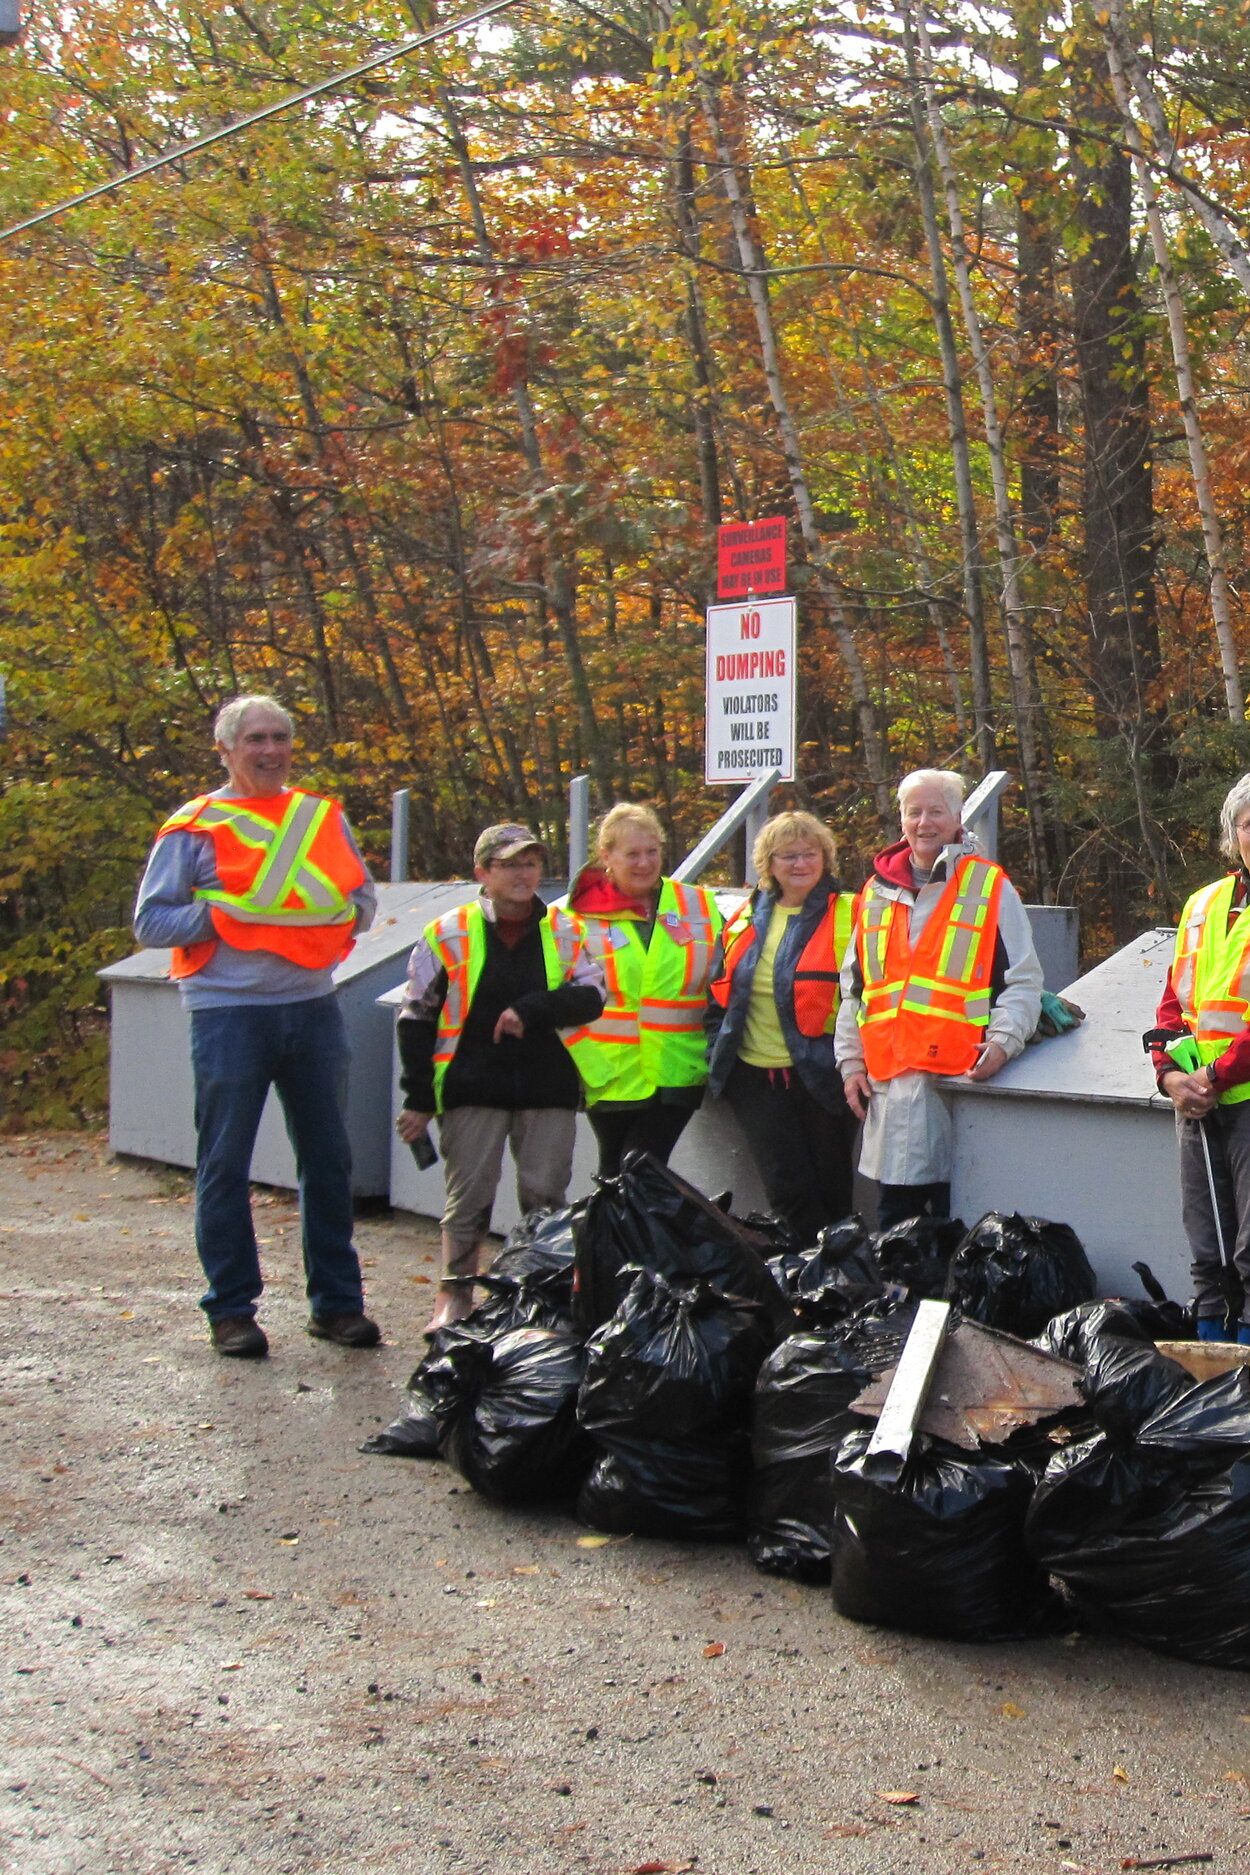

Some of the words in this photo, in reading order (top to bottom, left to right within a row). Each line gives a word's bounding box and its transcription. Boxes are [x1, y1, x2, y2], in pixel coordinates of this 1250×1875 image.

[740, 612, 761, 640] NO
[716, 649, 785, 681] DUMPING
[723, 693, 778, 715] VIOLATORS
[730, 722, 754, 741] WILL
[757, 721, 770, 740] BE
[717, 748, 782, 769] PROSECUTED
